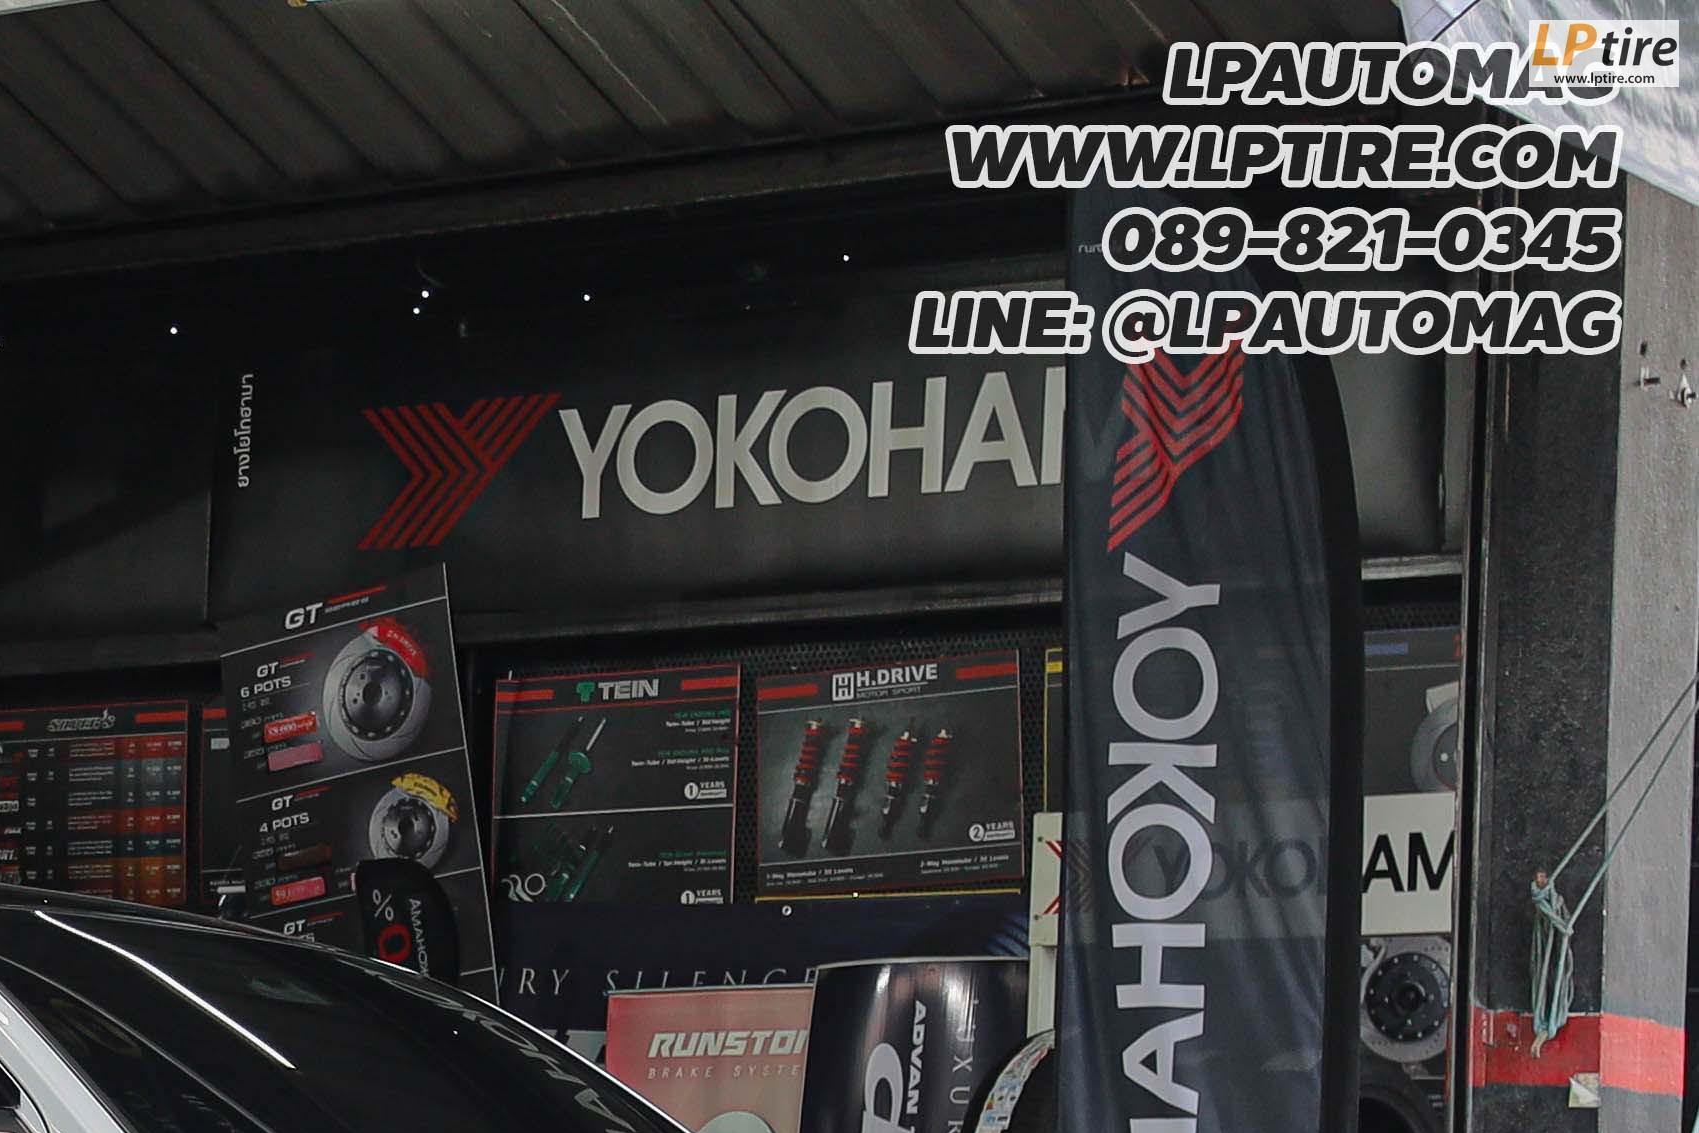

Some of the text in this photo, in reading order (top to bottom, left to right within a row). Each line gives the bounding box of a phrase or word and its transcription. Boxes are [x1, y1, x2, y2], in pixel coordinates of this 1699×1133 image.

[558, 367, 1066, 519] YOKOHA
[284, 602, 323, 630] GT
[256, 662, 279, 678] GT
[856, 664, 938, 687] H.DRIVE
[254, 676, 292, 695] POTS
[598, 679, 660, 700] TEIN
[271, 795, 294, 811] GT
[259, 812, 310, 833] 4 POTS
[283, 919, 306, 935] GT
[906, 999, 928, 1115] ADVAN
[647, 1064, 801, 1080] BRAKE SYSTE
